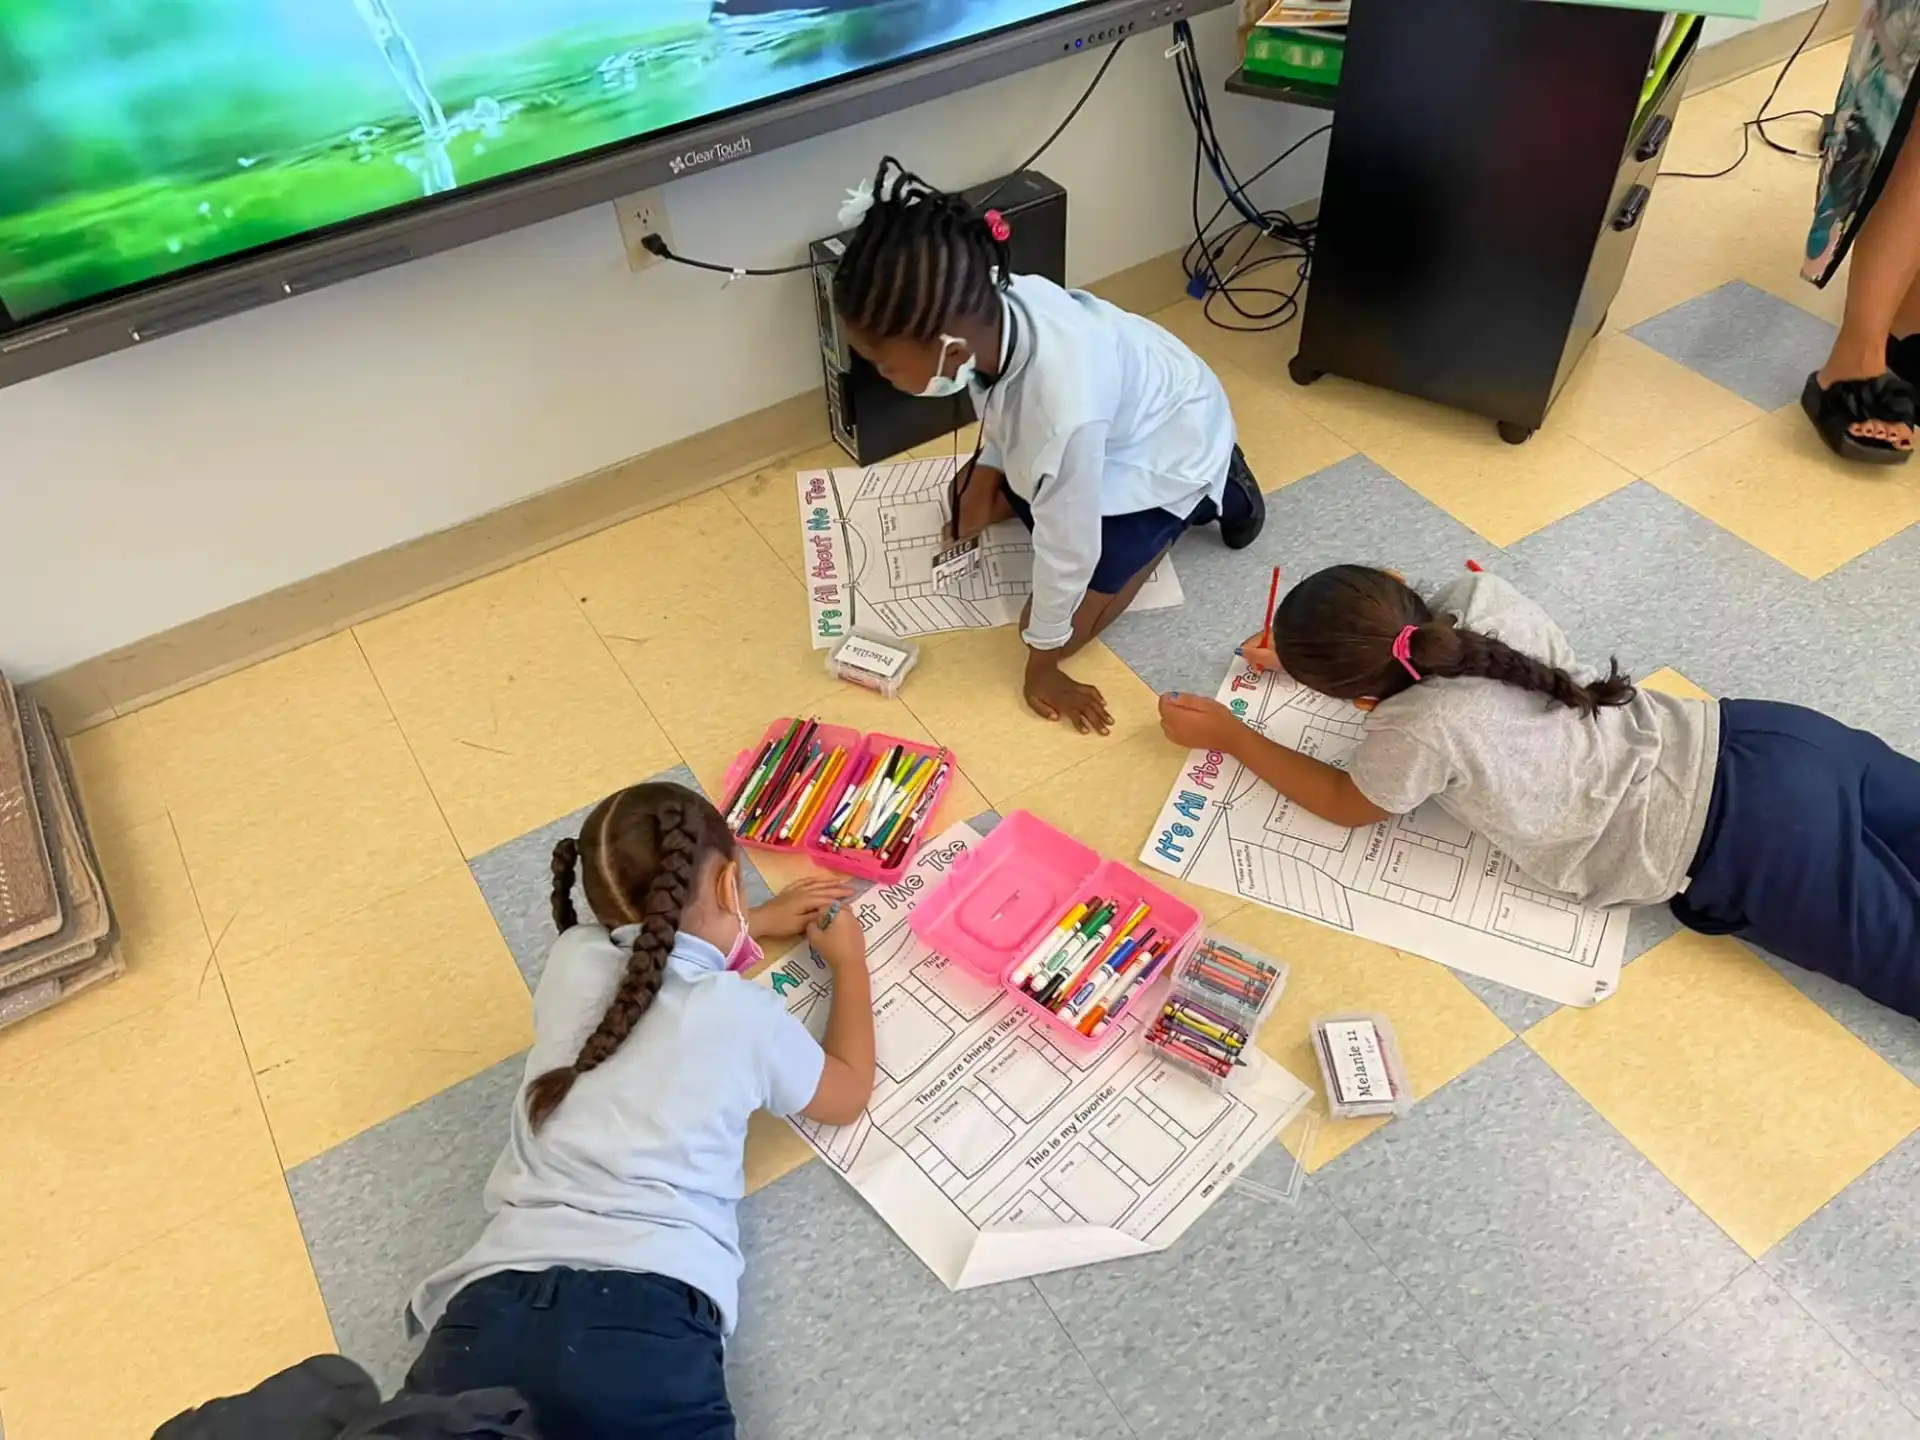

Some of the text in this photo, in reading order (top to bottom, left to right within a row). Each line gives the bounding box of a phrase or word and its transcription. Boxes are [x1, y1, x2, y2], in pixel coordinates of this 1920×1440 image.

[804, 478, 843, 637] It's All About Me Tee
[1188, 749, 1224, 790] Abo
[1173, 790, 1207, 822] All
[1155, 822, 1194, 863] It's
[1365, 823, 1386, 862] These are
[878, 875, 924, 910] Me
[917, 840, 969, 872] Tee
[1486, 860, 1499, 878] This
[915, 1079, 948, 1106] These
[947, 1063, 964, 1081] are
[963, 1036, 996, 1065] things
[993, 1029, 1001, 1037] I
[998, 1016, 1017, 1032] like
[1349, 1046, 1373, 1097] Melanie
[1025, 1085, 1116, 1169] This is my favorite:
